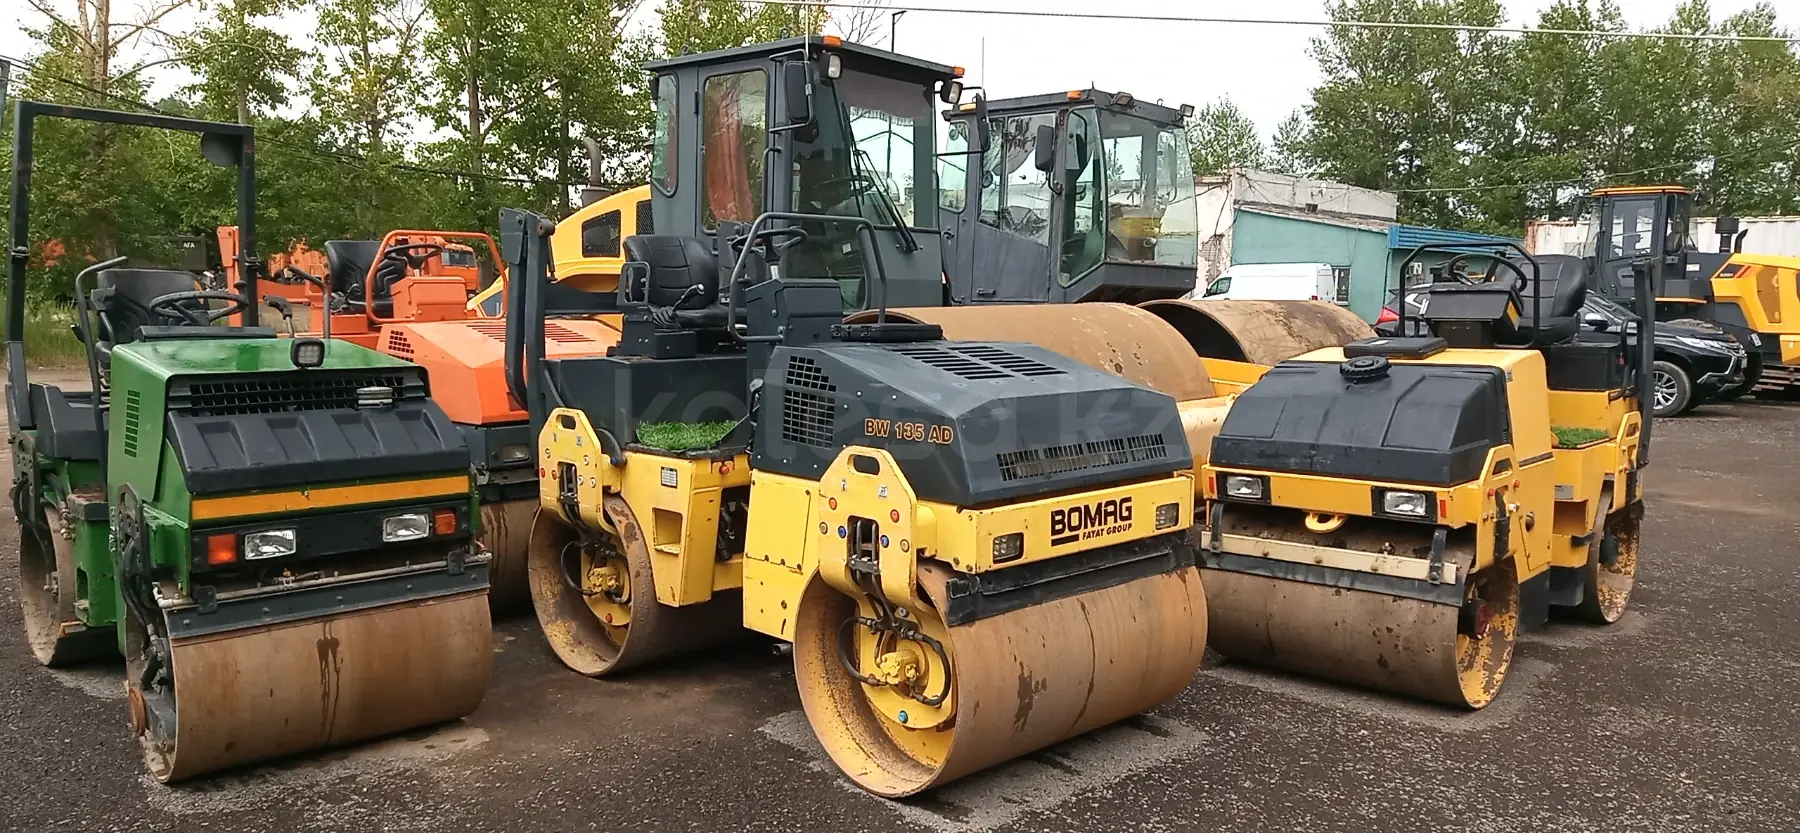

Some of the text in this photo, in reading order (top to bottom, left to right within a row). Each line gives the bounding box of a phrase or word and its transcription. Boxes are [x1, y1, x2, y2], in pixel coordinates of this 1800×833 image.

[864, 418, 953, 444] BW 135 AD
[1051, 496, 1132, 536] BOMAG
[1082, 523, 1132, 540] FAYAT GROUP
